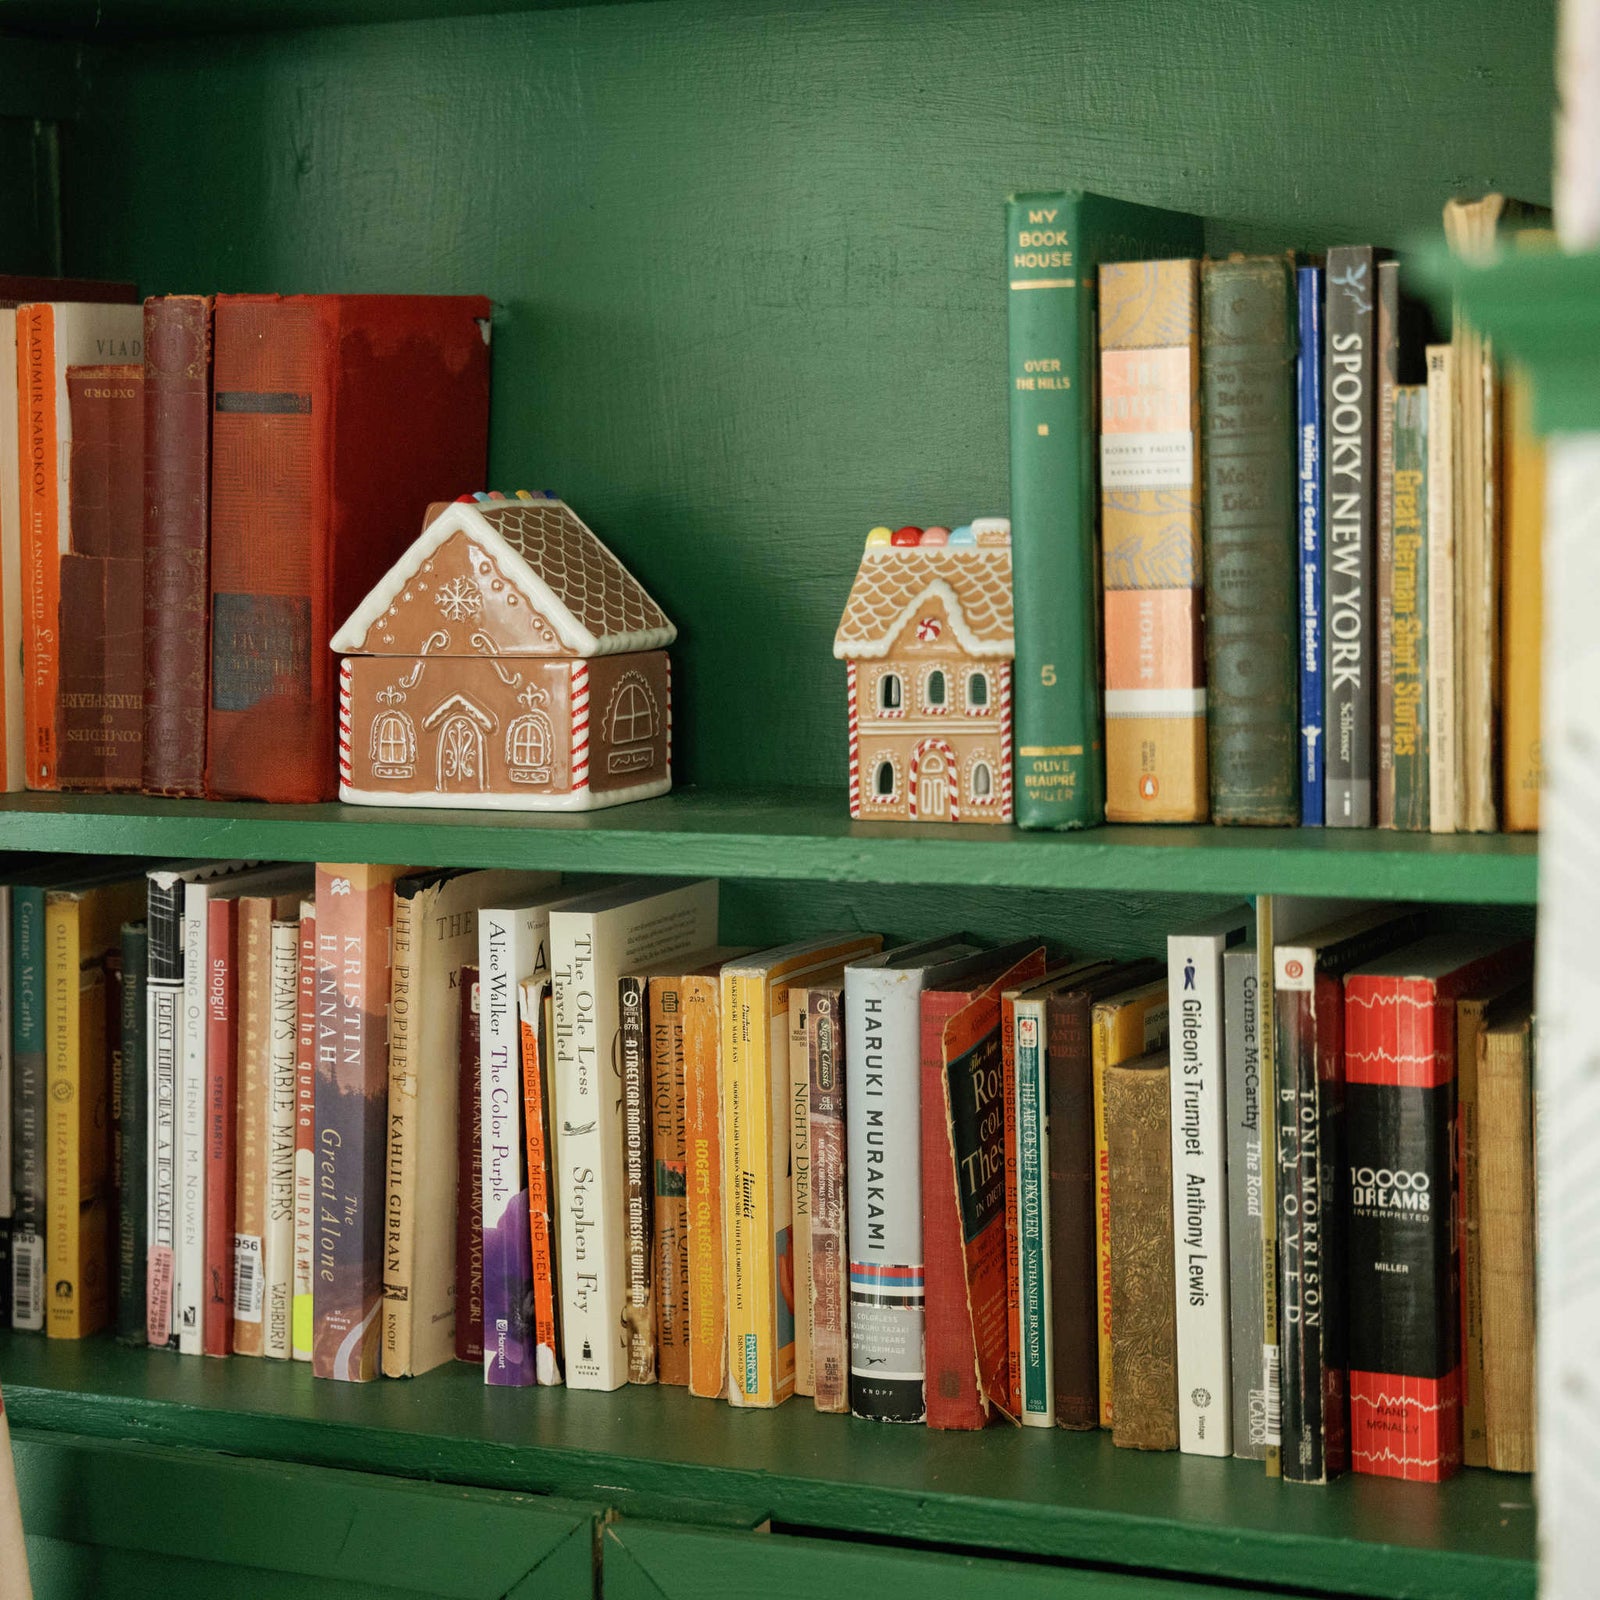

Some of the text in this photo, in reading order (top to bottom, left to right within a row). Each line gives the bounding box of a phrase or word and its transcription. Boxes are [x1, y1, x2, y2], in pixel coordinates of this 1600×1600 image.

[1014, 251, 1072, 268] HOUSE
[1019, 231, 1068, 247] BOOK
[1029, 209, 1057, 224] MY
[84, 388, 135, 399] OXFORD
[97, 339, 142, 356] VLAD
[1016, 376, 1071, 390] THE HILLS
[1024, 359, 1061, 373] OVER
[32, 315, 53, 687] VLADIMIR NABOKOV Lolita
[1381, 383, 1393, 562] KILLING THE BLACK DOG
[1300, 423, 1317, 672] Waiting for Godot Samuel Beckett
[1331, 333, 1363, 762] SPOOKY NEW YORK Schlosser
[1139, 601, 1154, 680] HOMER
[1394, 470, 1424, 756] Great German Short Stories
[1041, 664, 1057, 686] 5
[67, 729, 142, 742] COMEDIES
[436, 910, 474, 941] THE
[158, 997, 173, 1041] ERNEST
[246, 918, 258, 1157] FRANZ KAFKA THE
[320, 933, 337, 1064] HANNAH
[343, 936, 361, 1066] KRISTIN
[554, 965, 574, 1062] Travelled
[574, 933, 595, 1095] The Ode Less
[819, 1021, 832, 1087] Signet Classic
[21, 901, 36, 1213] Cormac McCarthy ALL THE PRETTY
[56, 924, 68, 1265] OLIVE KITTERIDGE ELIZABETH STROUT
[210, 959, 228, 1160] shopgirl STEVE MARTIN
[297, 941, 315, 1281] after the quake MURAKAMI
[489, 921, 509, 1202] Alice Walker The Color Purple
[655, 1024, 672, 1137] REMARQUE
[1241, 976, 1262, 1216] Cormac McCarthy The Road
[158, 1140, 173, 1150] A
[271, 941, 297, 1350] TIFFANY'S TABLE MANNERS WASHBURN
[387, 900, 411, 1353] THE PROPHET KAHLIL GIBRAN KNOPF
[525, 1042, 546, 1281] STEINBECK OF MICE AND MEN
[626, 1039, 645, 1308] A STREETCAR NAMED DESIRE TENNESSEE WILLIAMS
[795, 1082, 810, 1216] NIGHT'S DREAM
[865, 998, 885, 1250] HARUKI MURAKAMI
[1004, 1016, 1020, 1309] JOHN STEINBECK OF MICE AND MEN
[1181, 998, 1209, 1306] Gideon's Trumpet Anthony Lewis
[321, 1128, 342, 1282] Great Alone
[344, 1194, 358, 1226] The
[470, 1148, 482, 1325] THE DIARY YOUNG GIRL
[570, 1167, 598, 1313] Stephen Fry
[695, 1139, 714, 1344] ROGET'S COLLEGE THESAURUS
[743, 1171, 756, 1219] Hamlet
[1022, 1081, 1040, 1367] THE ART OF SELF-DISCOVERY NATHANIEL BRANDEN
[1281, 1089, 1300, 1324] BELOVED
[1300, 1089, 1319, 1327] TONI MORRISON
[1353, 1187, 1430, 1211] DREAMS
[1353, 1208, 1430, 1222] INTERPRETED
[660, 1227, 678, 1347] Western Front
[825, 1240, 835, 1285] CHARLES
[826, 1287, 836, 1332] DICKENS
[1265, 1238, 1274, 1328] MEADOWLANDS
[1374, 1261, 1409, 1274] MILLER
[498, 1332, 506, 1369] Harcourt
[746, 1335, 757, 1393] BARRON'S
[862, 1388, 893, 1397] KNOPF
[880, 1336, 906, 1344] YEARS
[1198, 1415, 1206, 1440] Vintage
[1250, 1389, 1266, 1445] PICADOR
[1376, 1405, 1408, 1418] RAND
